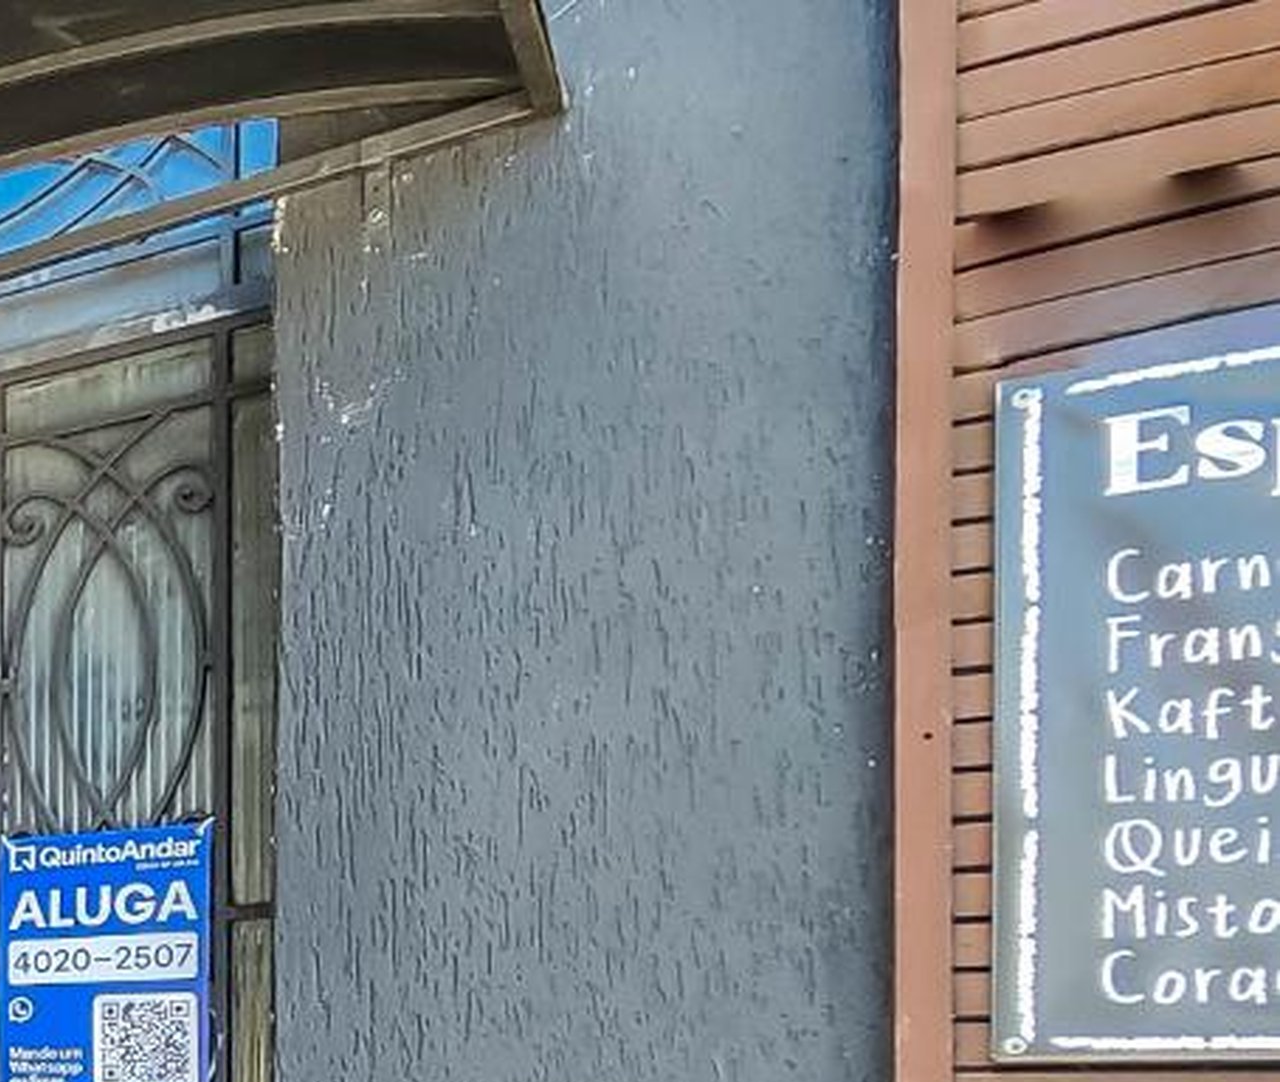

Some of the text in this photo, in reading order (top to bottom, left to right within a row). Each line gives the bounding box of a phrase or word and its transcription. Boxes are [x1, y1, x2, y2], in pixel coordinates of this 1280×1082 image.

[1103, 405, 1280, 498] Es
[1106, 684, 1275, 739] Kaft
[1105, 754, 1280, 807] Lingu
[40, 836, 202, 868] QuintoAndar
[1104, 816, 1271, 877] Quei
[9, 880, 198, 931] ALUGA
[1100, 885, 1280, 939] Misto
[13, 943, 193, 974] 4020-2507
[1100, 949, 1280, 1005] Cora
